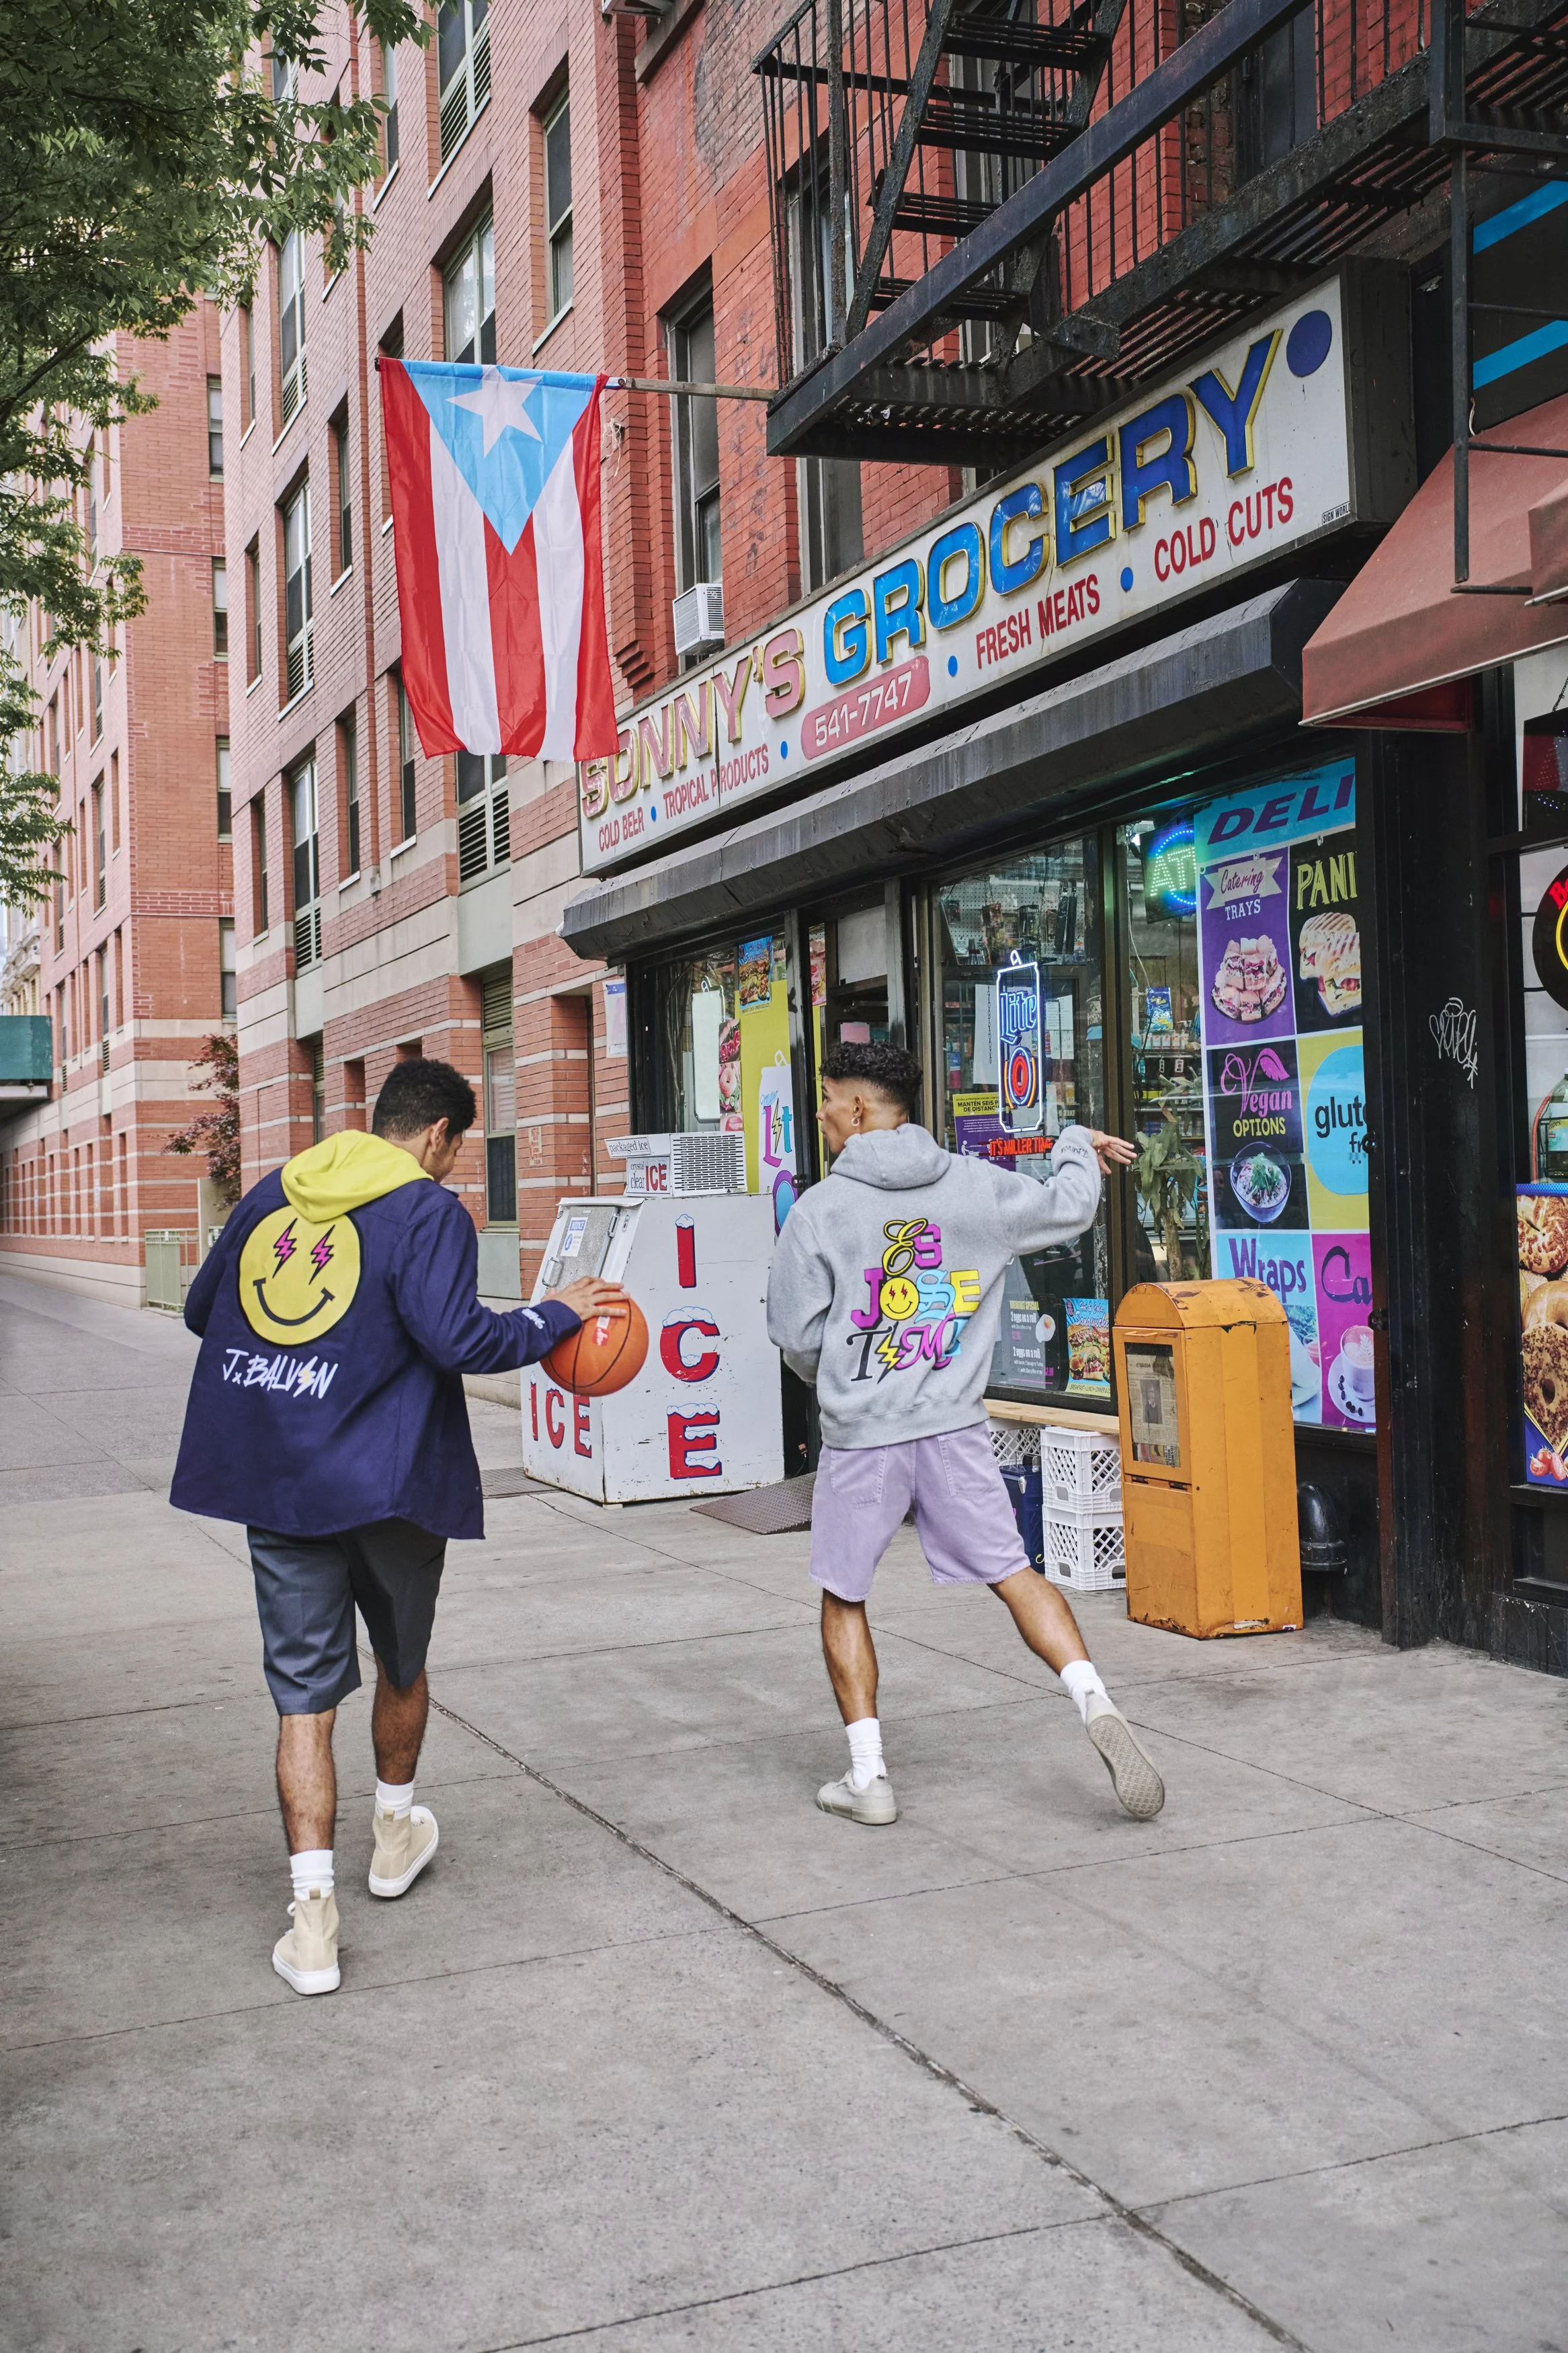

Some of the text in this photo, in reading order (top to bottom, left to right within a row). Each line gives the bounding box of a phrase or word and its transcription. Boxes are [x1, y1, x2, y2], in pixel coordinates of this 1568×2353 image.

[1154, 477, 1294, 582] COLD CUTS
[1323, 504, 1350, 523] SIGN WORL
[580, 329, 1283, 819] SONNY'S GROCERY
[976, 573, 1101, 669] FRESH MEATS
[815, 671, 912, 747] 541-7747
[663, 743, 770, 820] TROPICAL PRODUCTS
[598, 807, 645, 852] COLD BEER
[1207, 773, 1355, 845] DELI
[1221, 866, 1264, 894] Catering
[1225, 900, 1261, 921] TRAYS
[999, 990, 1038, 1045] Lite
[1221, 1048, 1292, 1119] Vegan
[609, 1141, 649, 1155] packaged ice
[990, 1138, 1003, 1156] IT'S
[1003, 1138, 1032, 1156] MILLER
[1233, 1117, 1286, 1138] OPTIONS
[630, 1162, 645, 1172] crystal
[630, 1162, 667, 1191] clear ICE
[1228, 1238, 1307, 1304] Wraps
[1010, 1311, 1014, 1322] 2
[1014, 1313, 1022, 1323] eggs
[1022, 1314, 1026, 1322] on
[1029, 1313, 1037, 1323] roll
[1012, 1346, 1016, 1356] 2
[1016, 1348, 1025, 1358] eggs
[1025, 1349, 1030, 1357] on
[1033, 1348, 1041, 1359] roll
[530, 1373, 593, 1458] ICE
